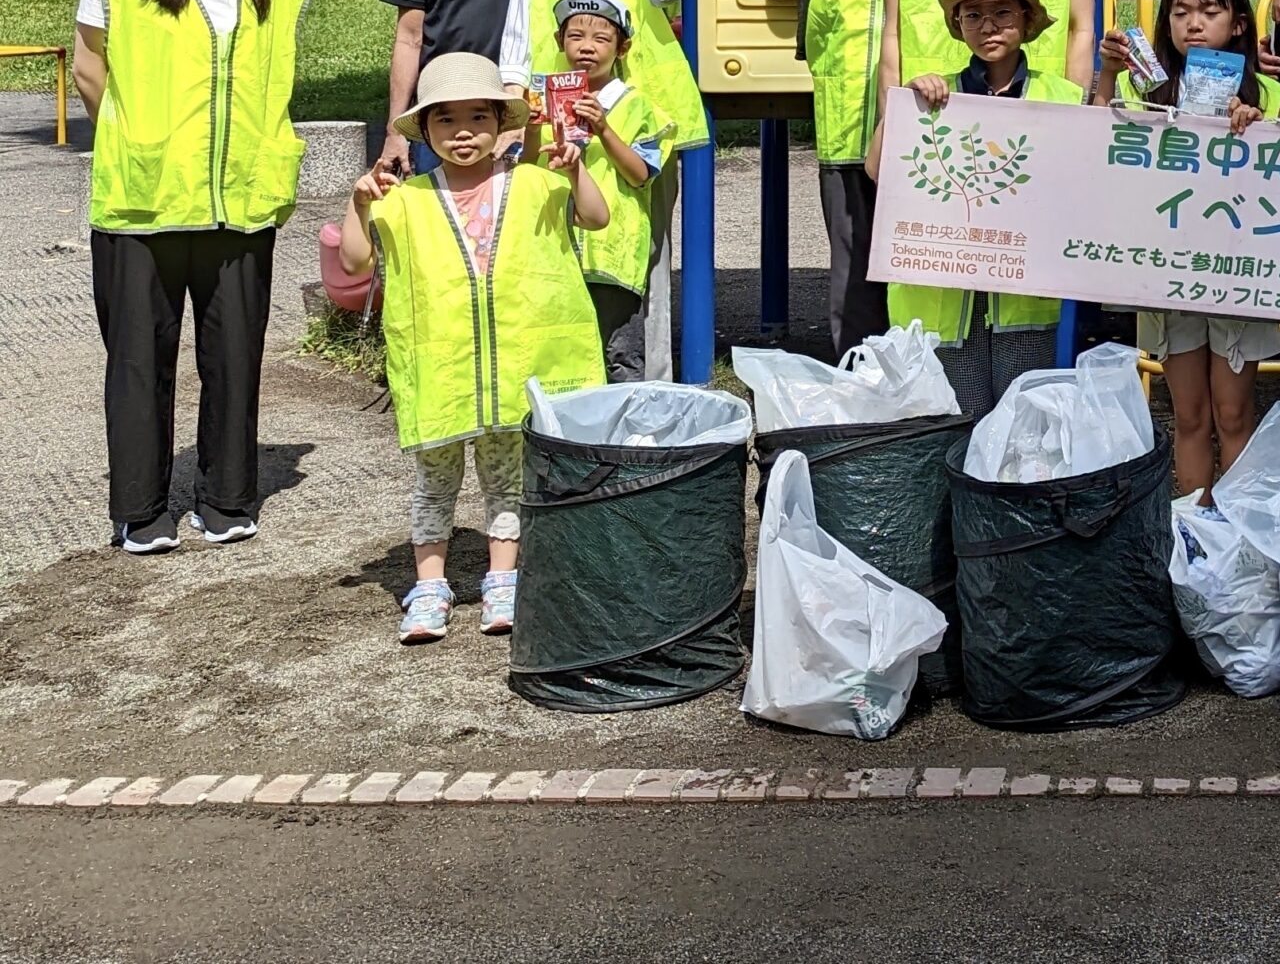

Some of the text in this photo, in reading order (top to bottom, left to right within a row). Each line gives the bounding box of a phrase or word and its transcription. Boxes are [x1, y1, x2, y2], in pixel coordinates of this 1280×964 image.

[894, 220, 1028, 247] 高島中央公園愛護会
[891, 242, 1026, 266] Takashima Central Park
[890, 256, 1025, 280] GARDENING CLUB
